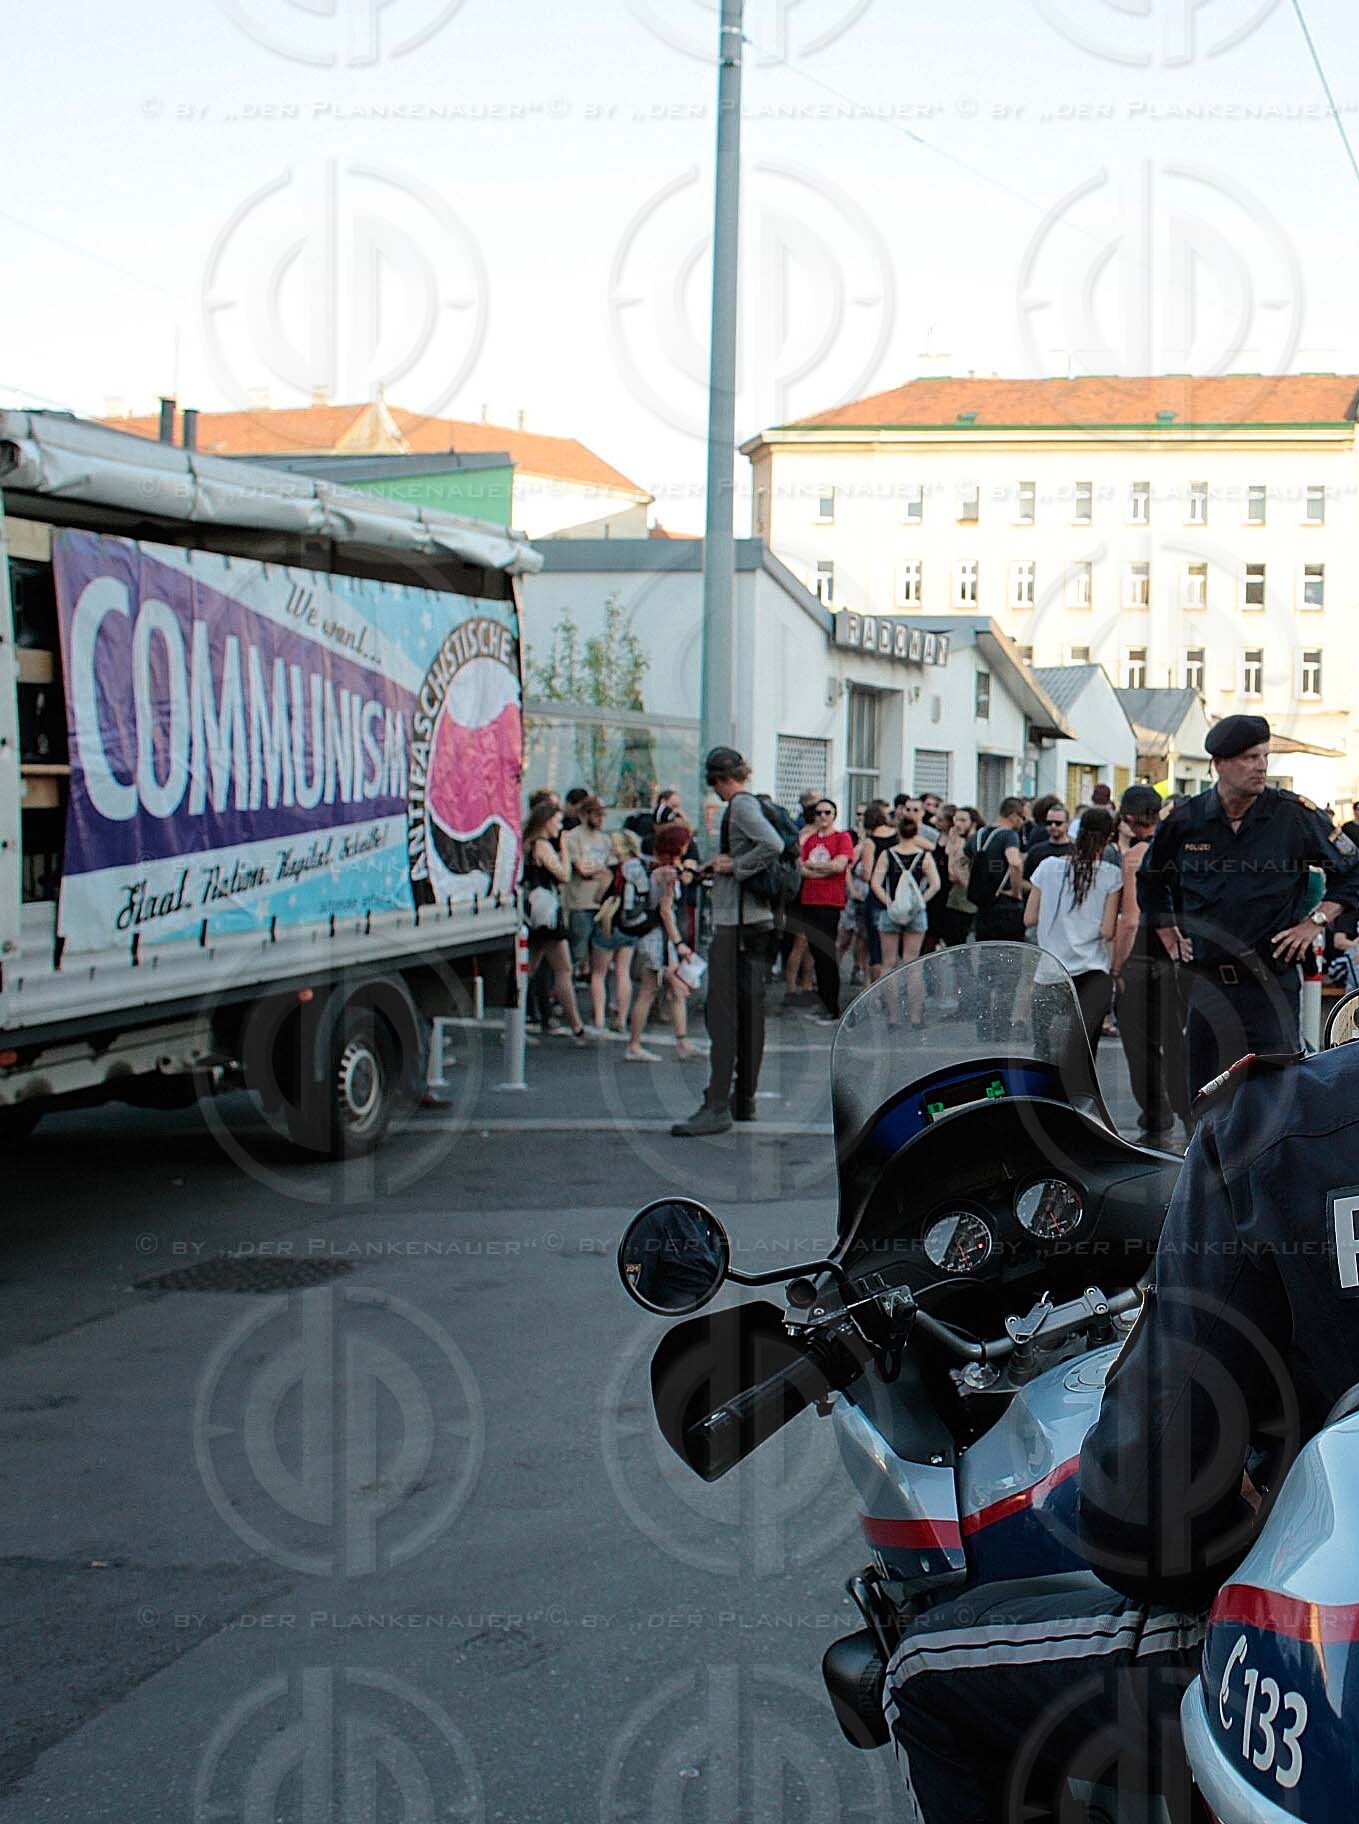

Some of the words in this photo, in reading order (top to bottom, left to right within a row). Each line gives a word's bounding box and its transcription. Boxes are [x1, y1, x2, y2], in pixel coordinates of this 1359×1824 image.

[286, 583, 320, 626] We
[70, 575, 409, 822] COMMUNISM
[409, 619, 512, 882] ANTIFASCHISTISCHE
[1184, 843, 1211, 852] POLIZEI
[1242, 1668, 1308, 1789] 133
